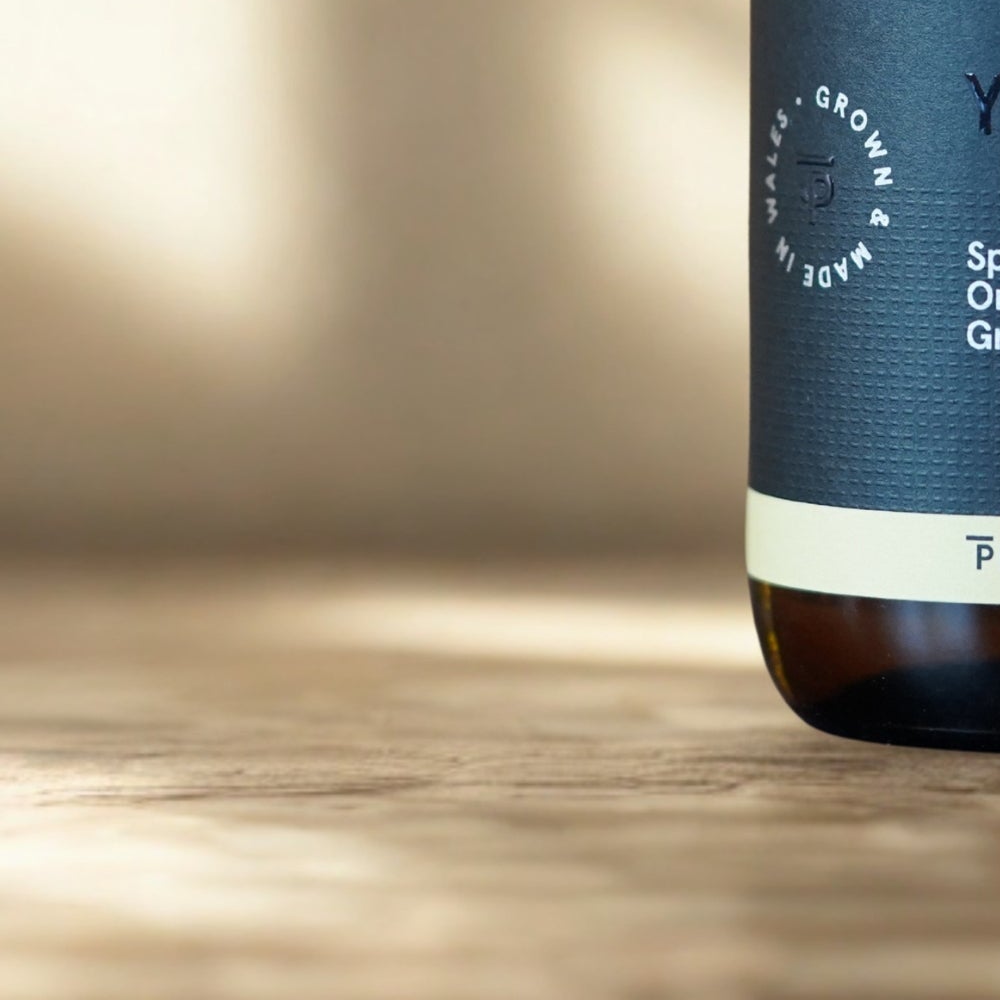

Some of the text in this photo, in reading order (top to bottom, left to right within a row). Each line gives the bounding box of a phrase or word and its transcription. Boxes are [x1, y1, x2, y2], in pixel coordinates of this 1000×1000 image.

[815, 85, 893, 186] GROWN
[765, 108, 788, 224] WALES
[870, 208, 890, 227] &
[776, 236, 795, 273] IN
[803, 241, 872, 288] MADE
